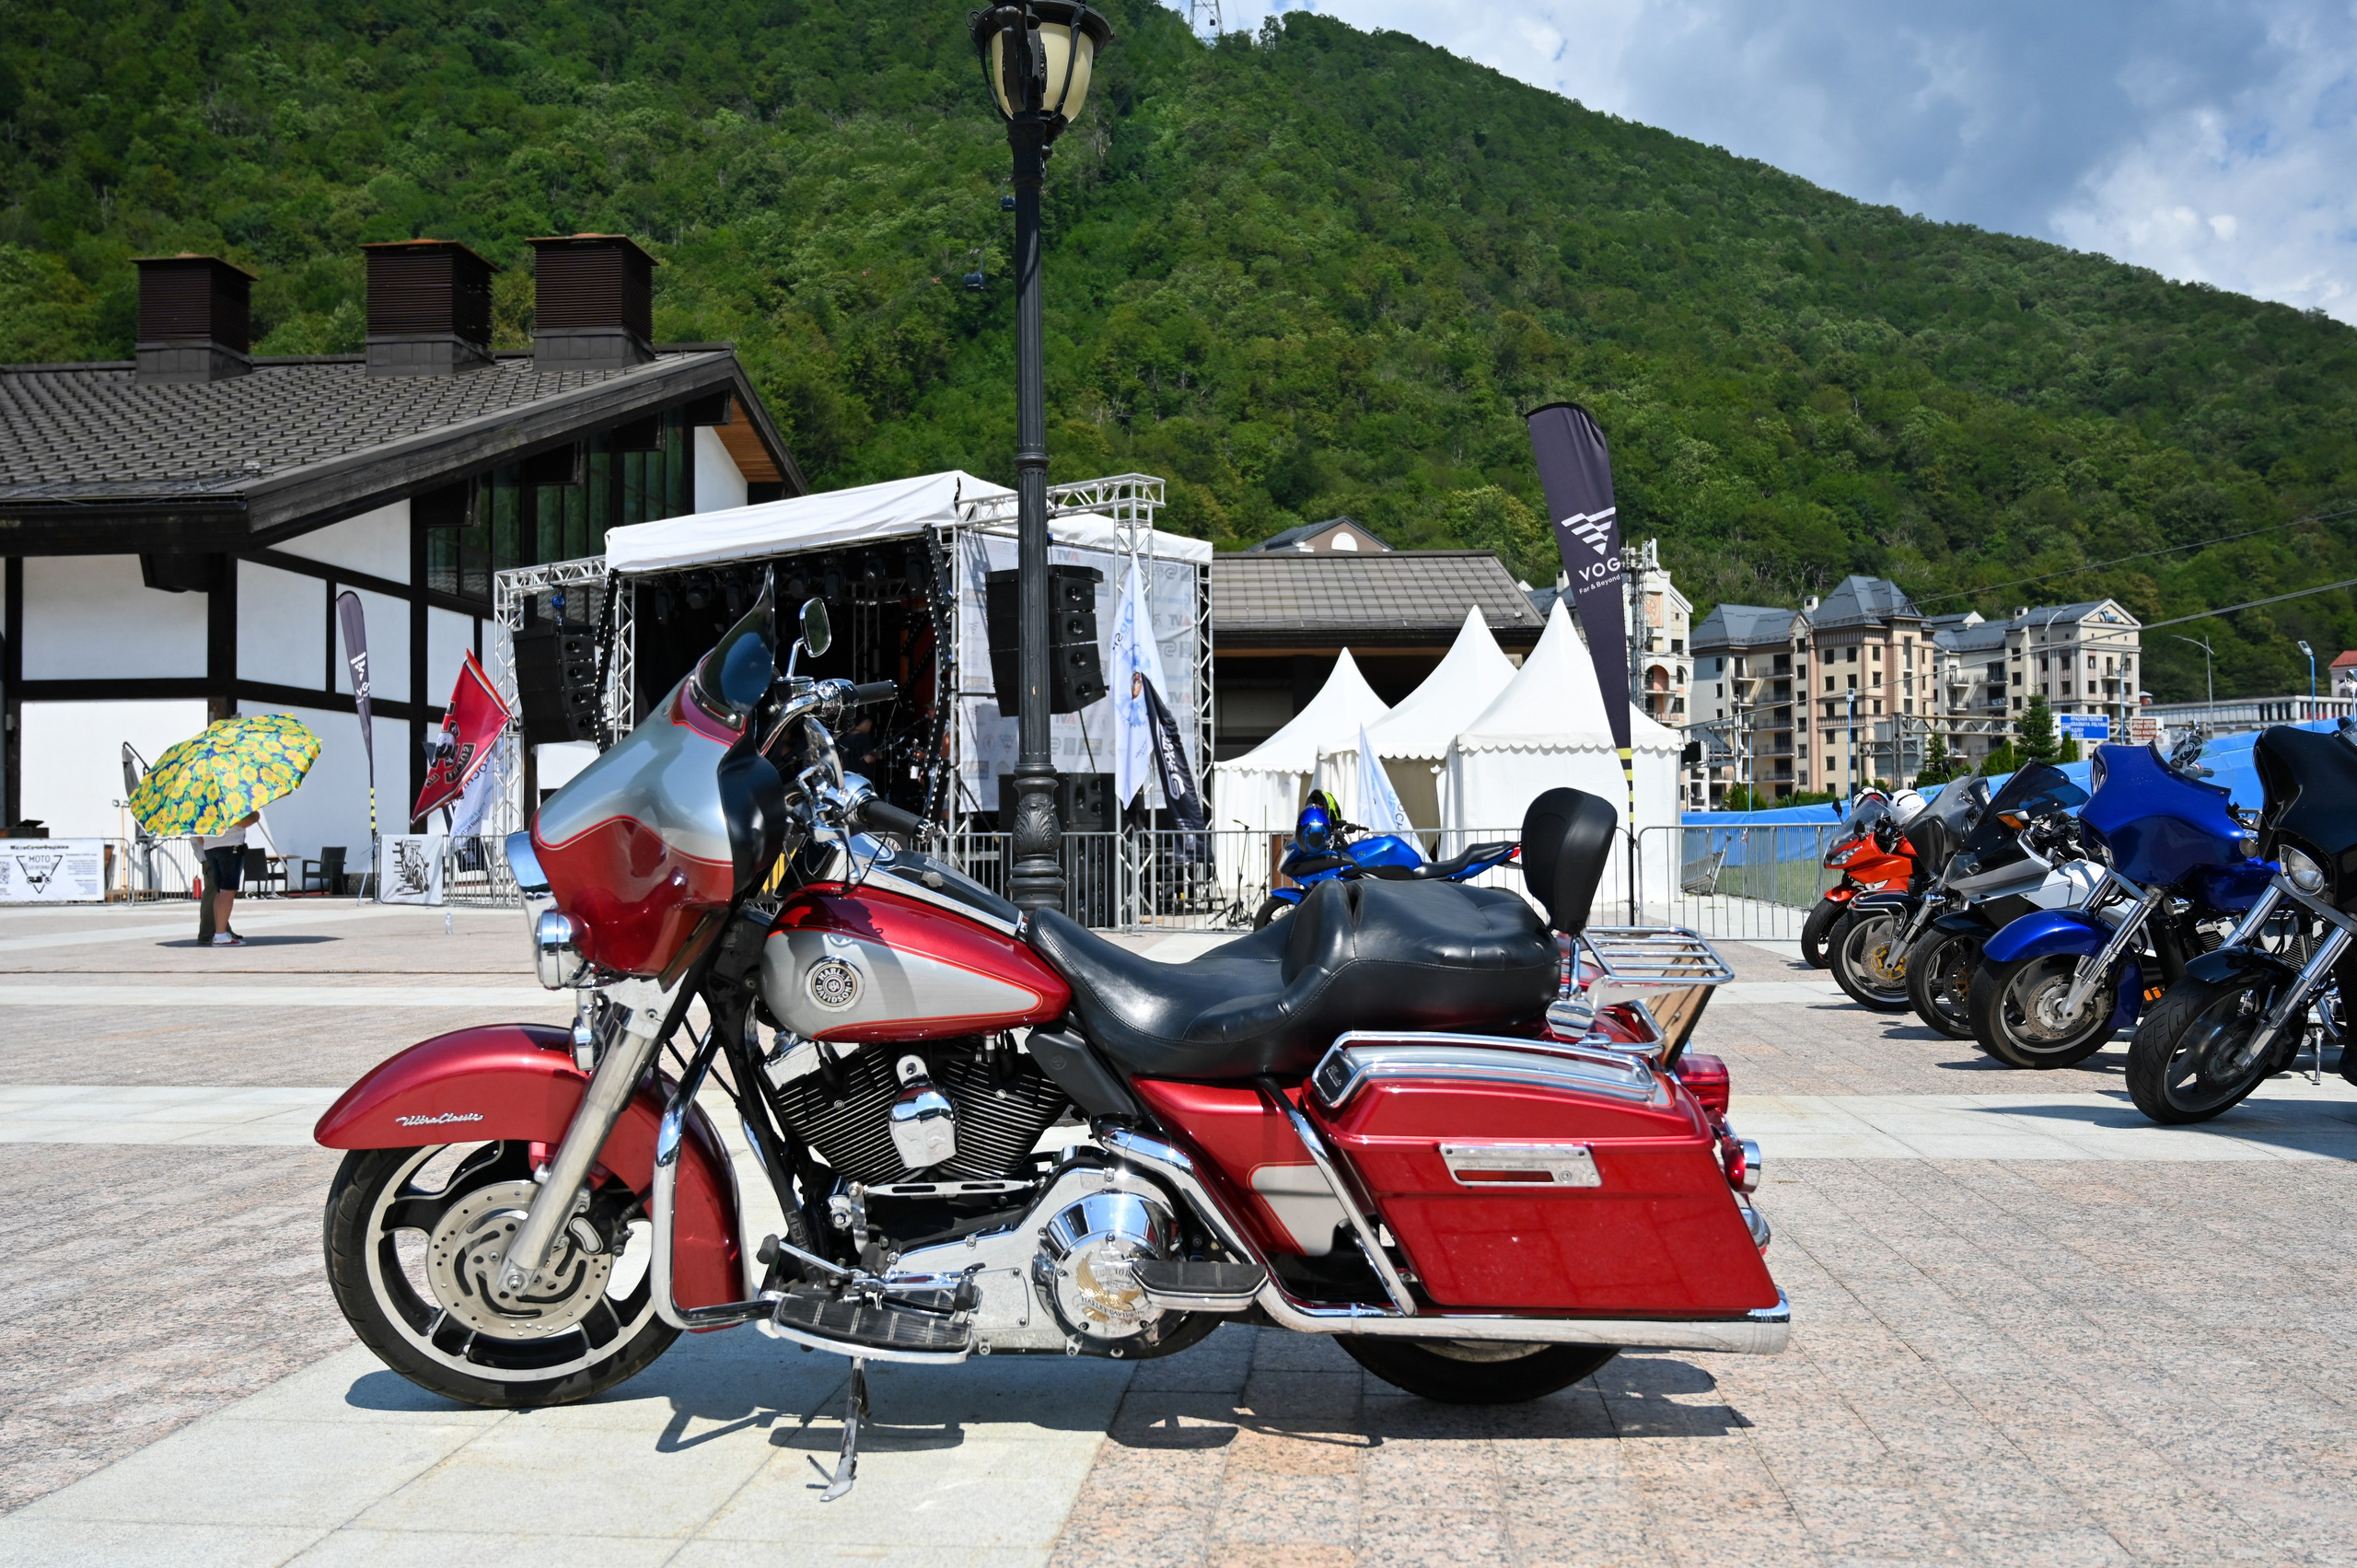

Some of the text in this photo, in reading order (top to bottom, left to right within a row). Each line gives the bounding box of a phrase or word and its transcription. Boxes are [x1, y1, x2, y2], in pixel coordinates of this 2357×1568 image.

[1596, 575, 1620, 587] Beyond
[818, 968, 852, 983] HARLEY
[816, 984, 853, 1004] DAVIDSON
